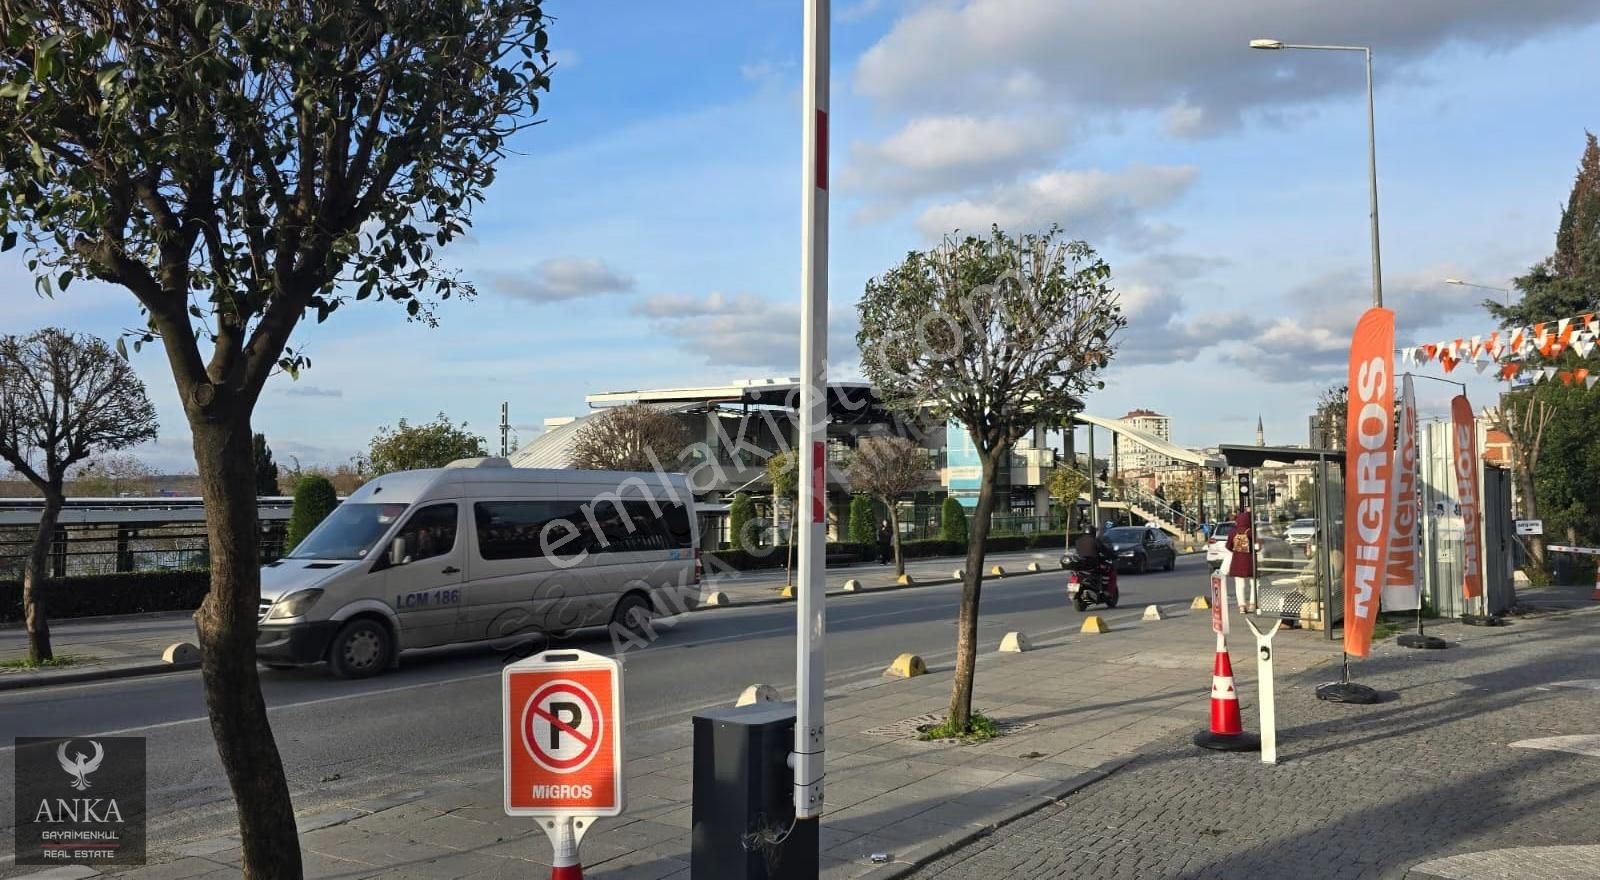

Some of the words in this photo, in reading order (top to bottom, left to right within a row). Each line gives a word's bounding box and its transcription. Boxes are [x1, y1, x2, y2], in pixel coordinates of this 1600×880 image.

[396, 592, 429, 609] LCM
[433, 589, 459, 605] 186
[549, 701, 582, 749] P
